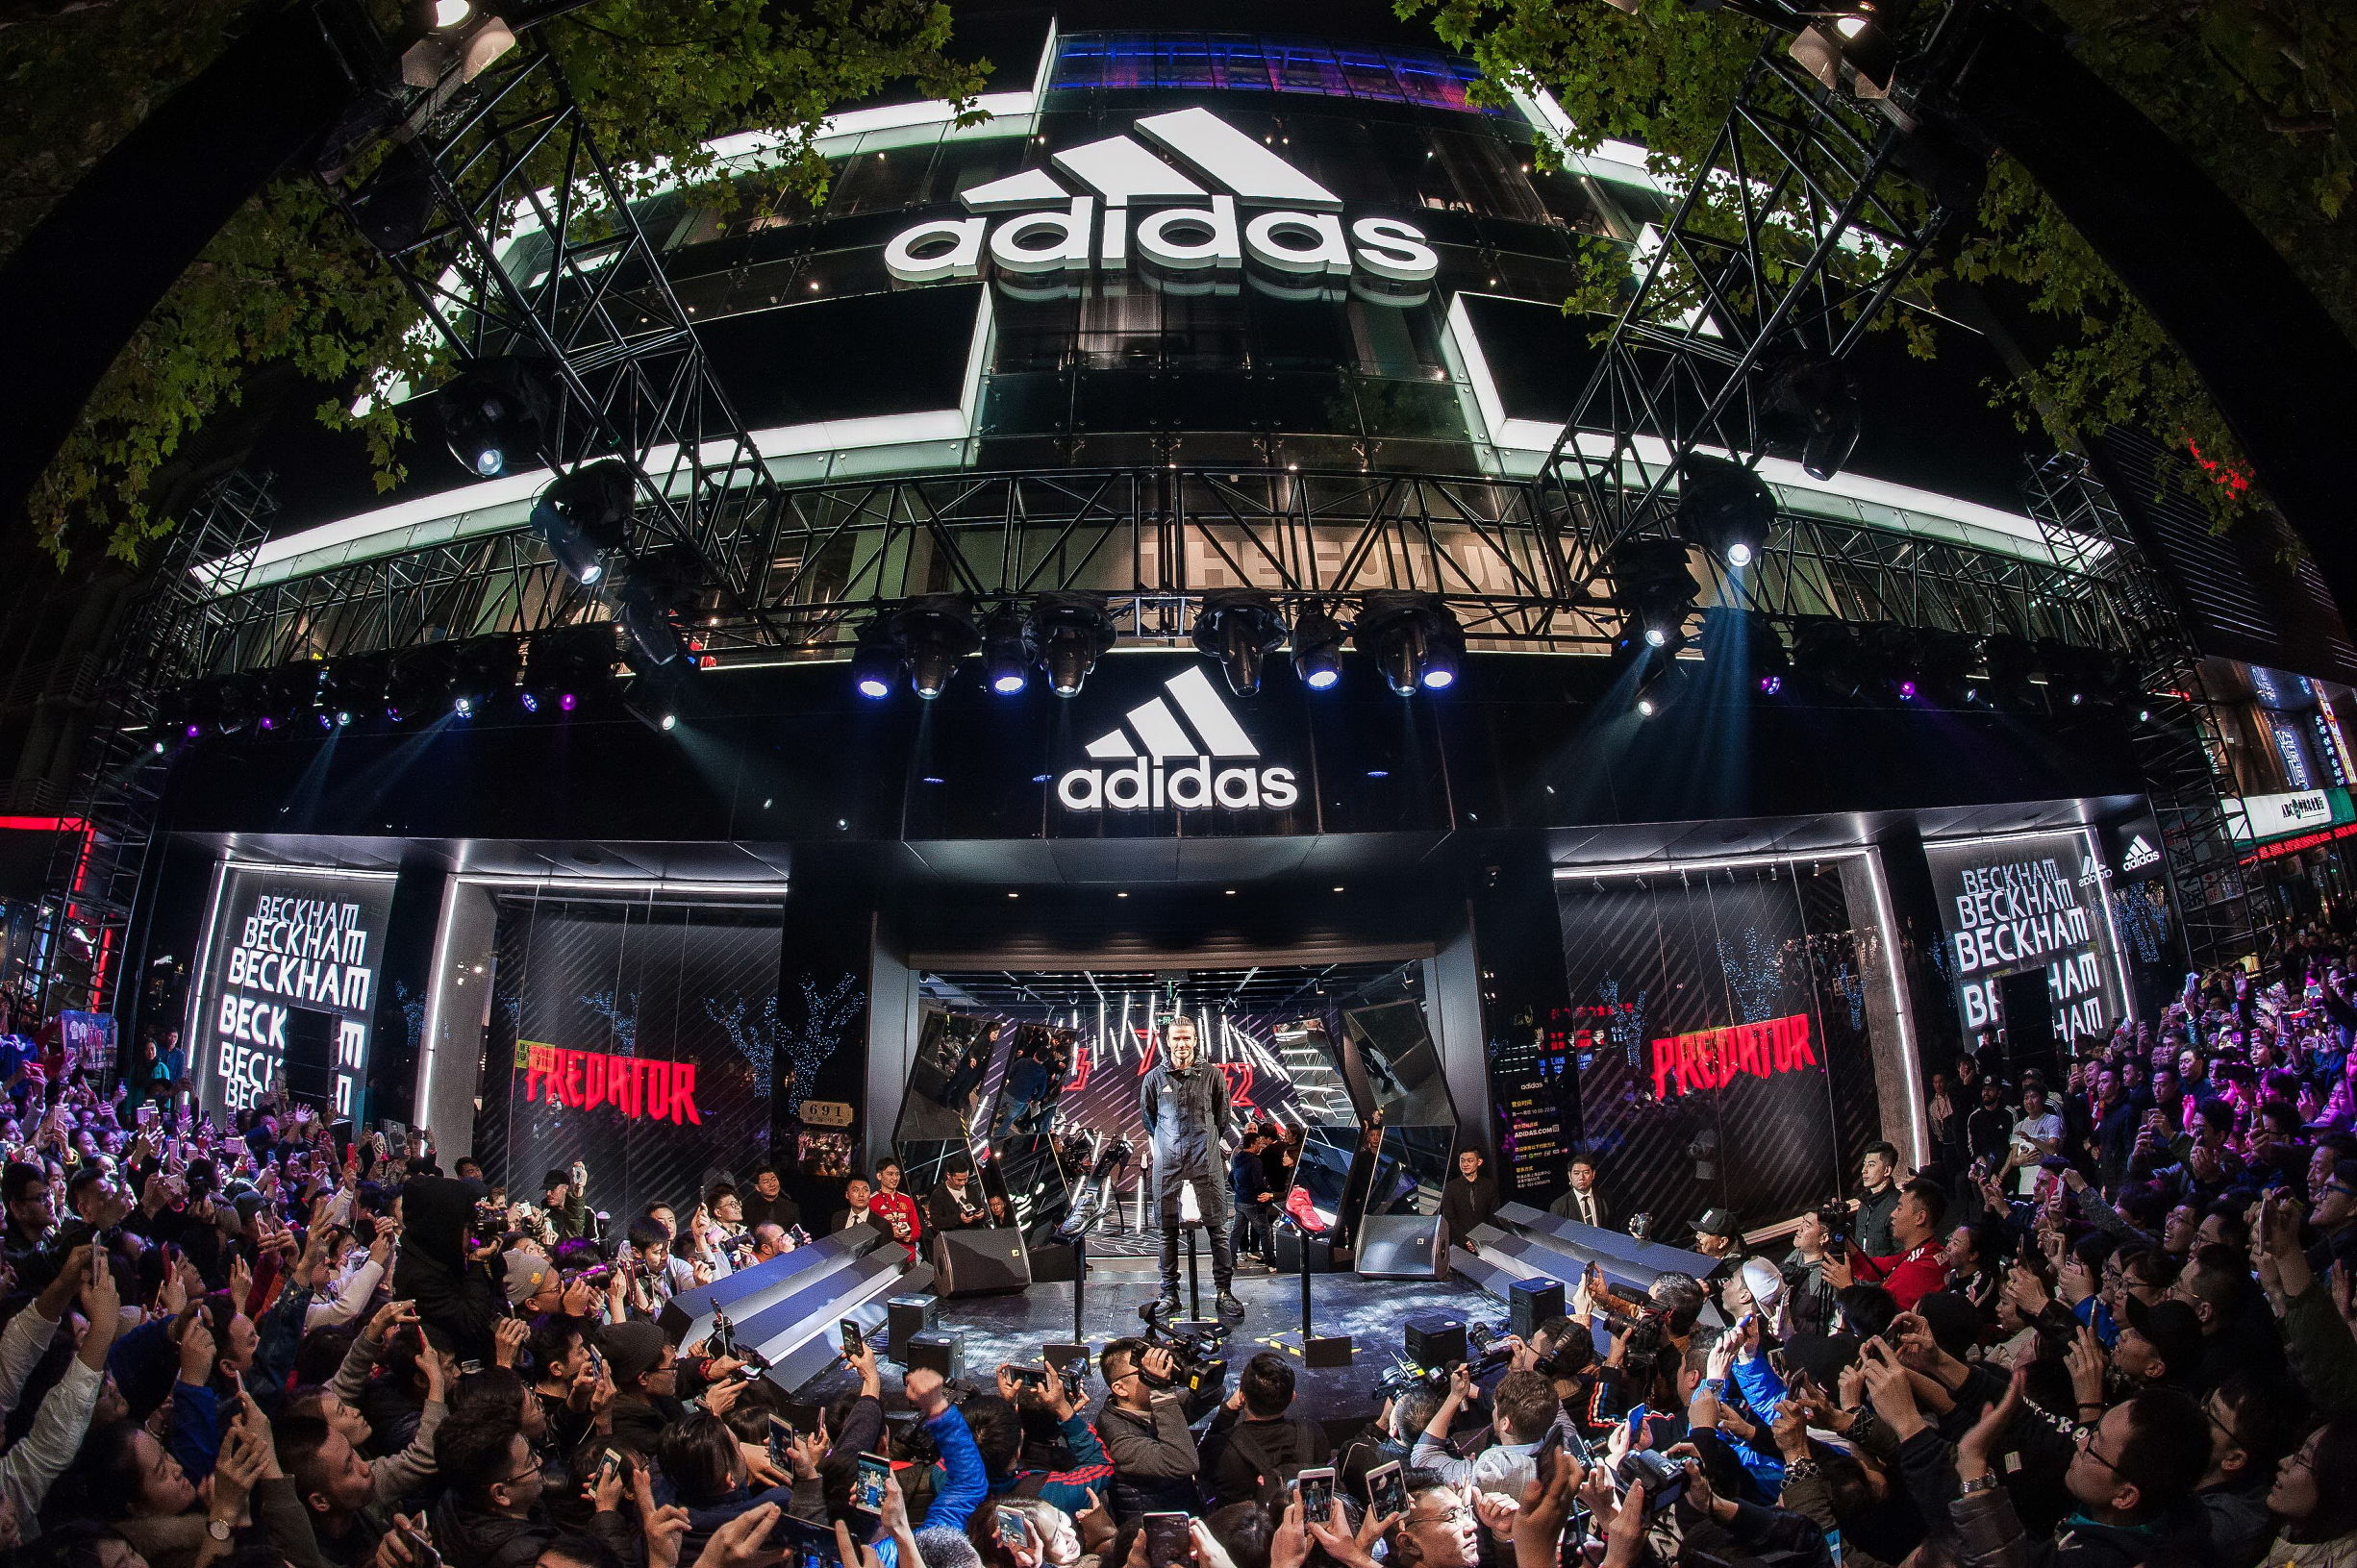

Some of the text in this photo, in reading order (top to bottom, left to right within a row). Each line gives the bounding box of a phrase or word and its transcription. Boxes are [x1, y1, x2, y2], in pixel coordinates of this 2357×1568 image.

[885, 195, 1439, 282] adidas
[1059, 756, 1299, 811] adidas
[1962, 859, 2060, 896] BECKHAM
[2123, 851, 2161, 871] adidas
[258, 895, 360, 931] BECKHAM
[1956, 879, 2075, 930] BECKHAM
[242, 916, 366, 965] BECKHAM
[1954, 907, 2090, 972] BECKHAM
[227, 947, 371, 1010] BECKHAM
[218, 994, 365, 1069] BECKM
[1651, 1013, 1818, 1103] PREDATOR
[524, 1043, 702, 1126] PREDATOR
[810, 1105, 840, 1116] 691
[1521, 1082, 1542, 1090] adidas
